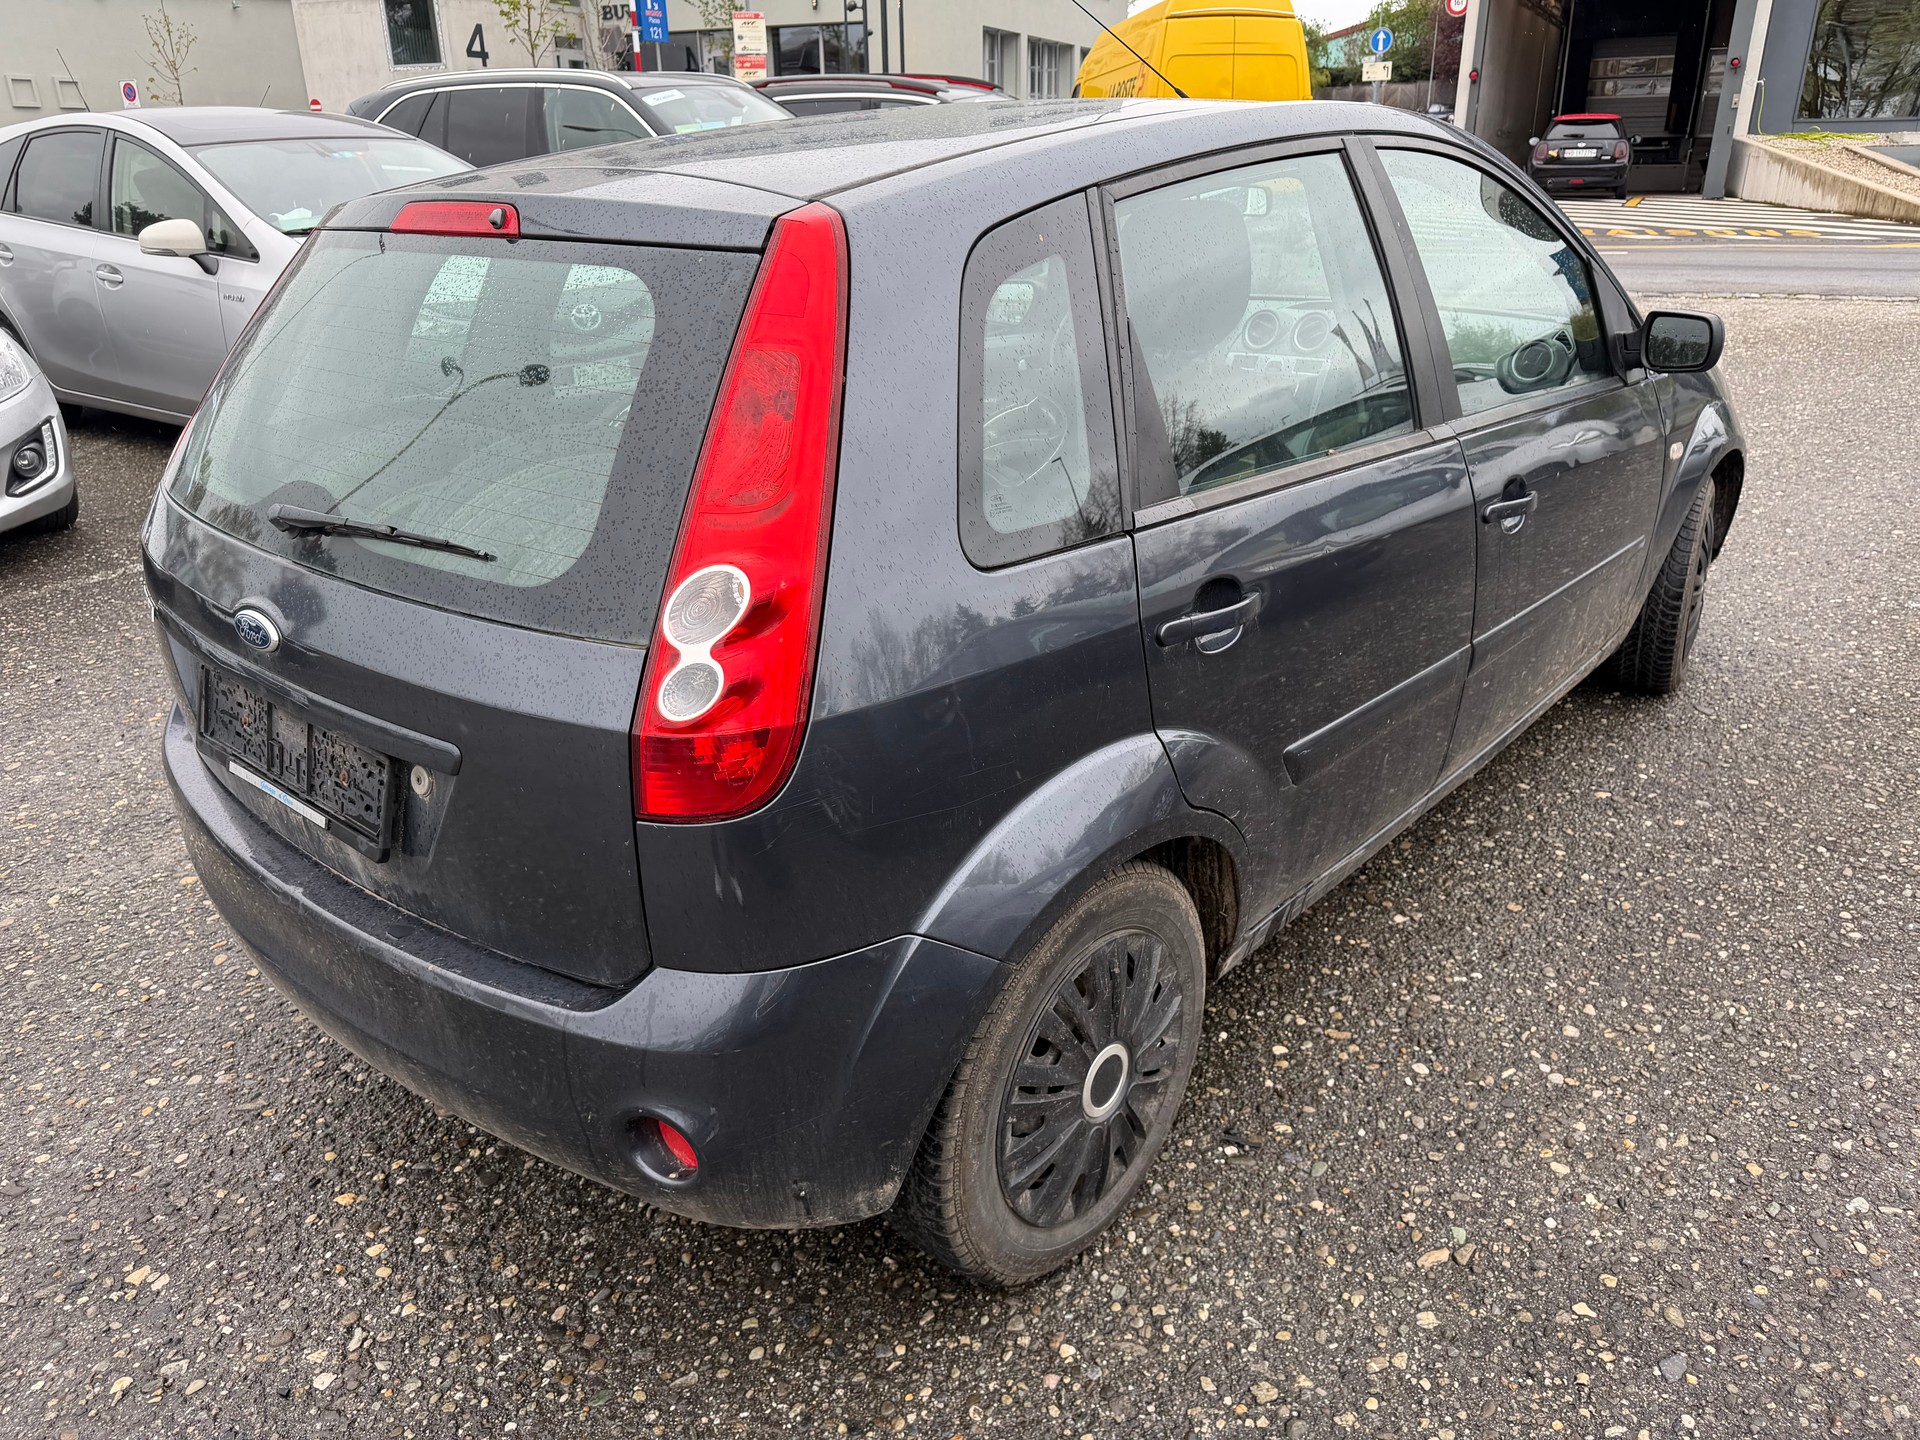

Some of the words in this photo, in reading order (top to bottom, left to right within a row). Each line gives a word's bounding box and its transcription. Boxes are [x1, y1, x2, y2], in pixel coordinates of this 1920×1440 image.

[466, 23, 489, 67] 4
[649, 26, 663, 39] 121
[237, 617, 266, 645] Ford
